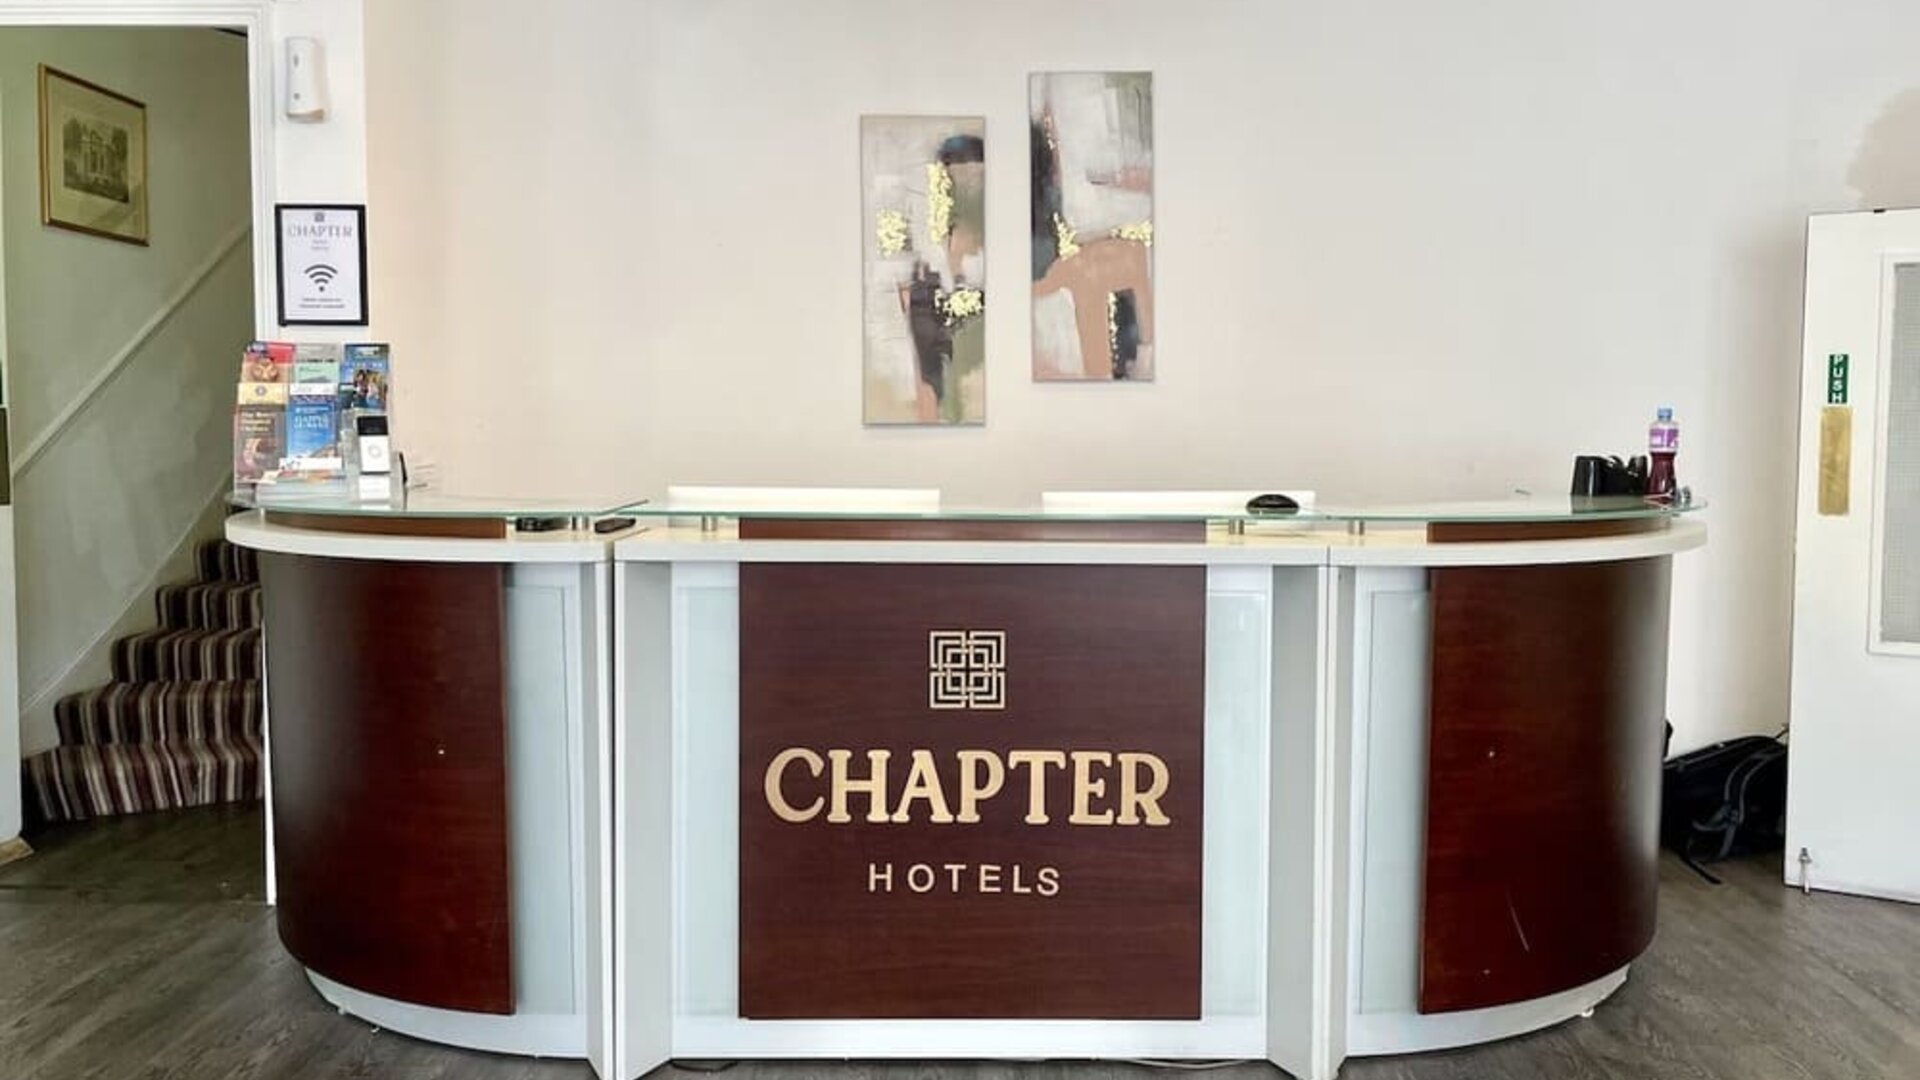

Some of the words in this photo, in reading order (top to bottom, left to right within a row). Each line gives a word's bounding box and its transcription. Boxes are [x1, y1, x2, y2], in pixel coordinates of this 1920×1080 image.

[287, 224, 353, 238] CHAPTER
[1832, 354, 1844, 403] PUSH
[764, 748, 1171, 826] CHAPTER
[869, 863, 1059, 896] HOTELS
